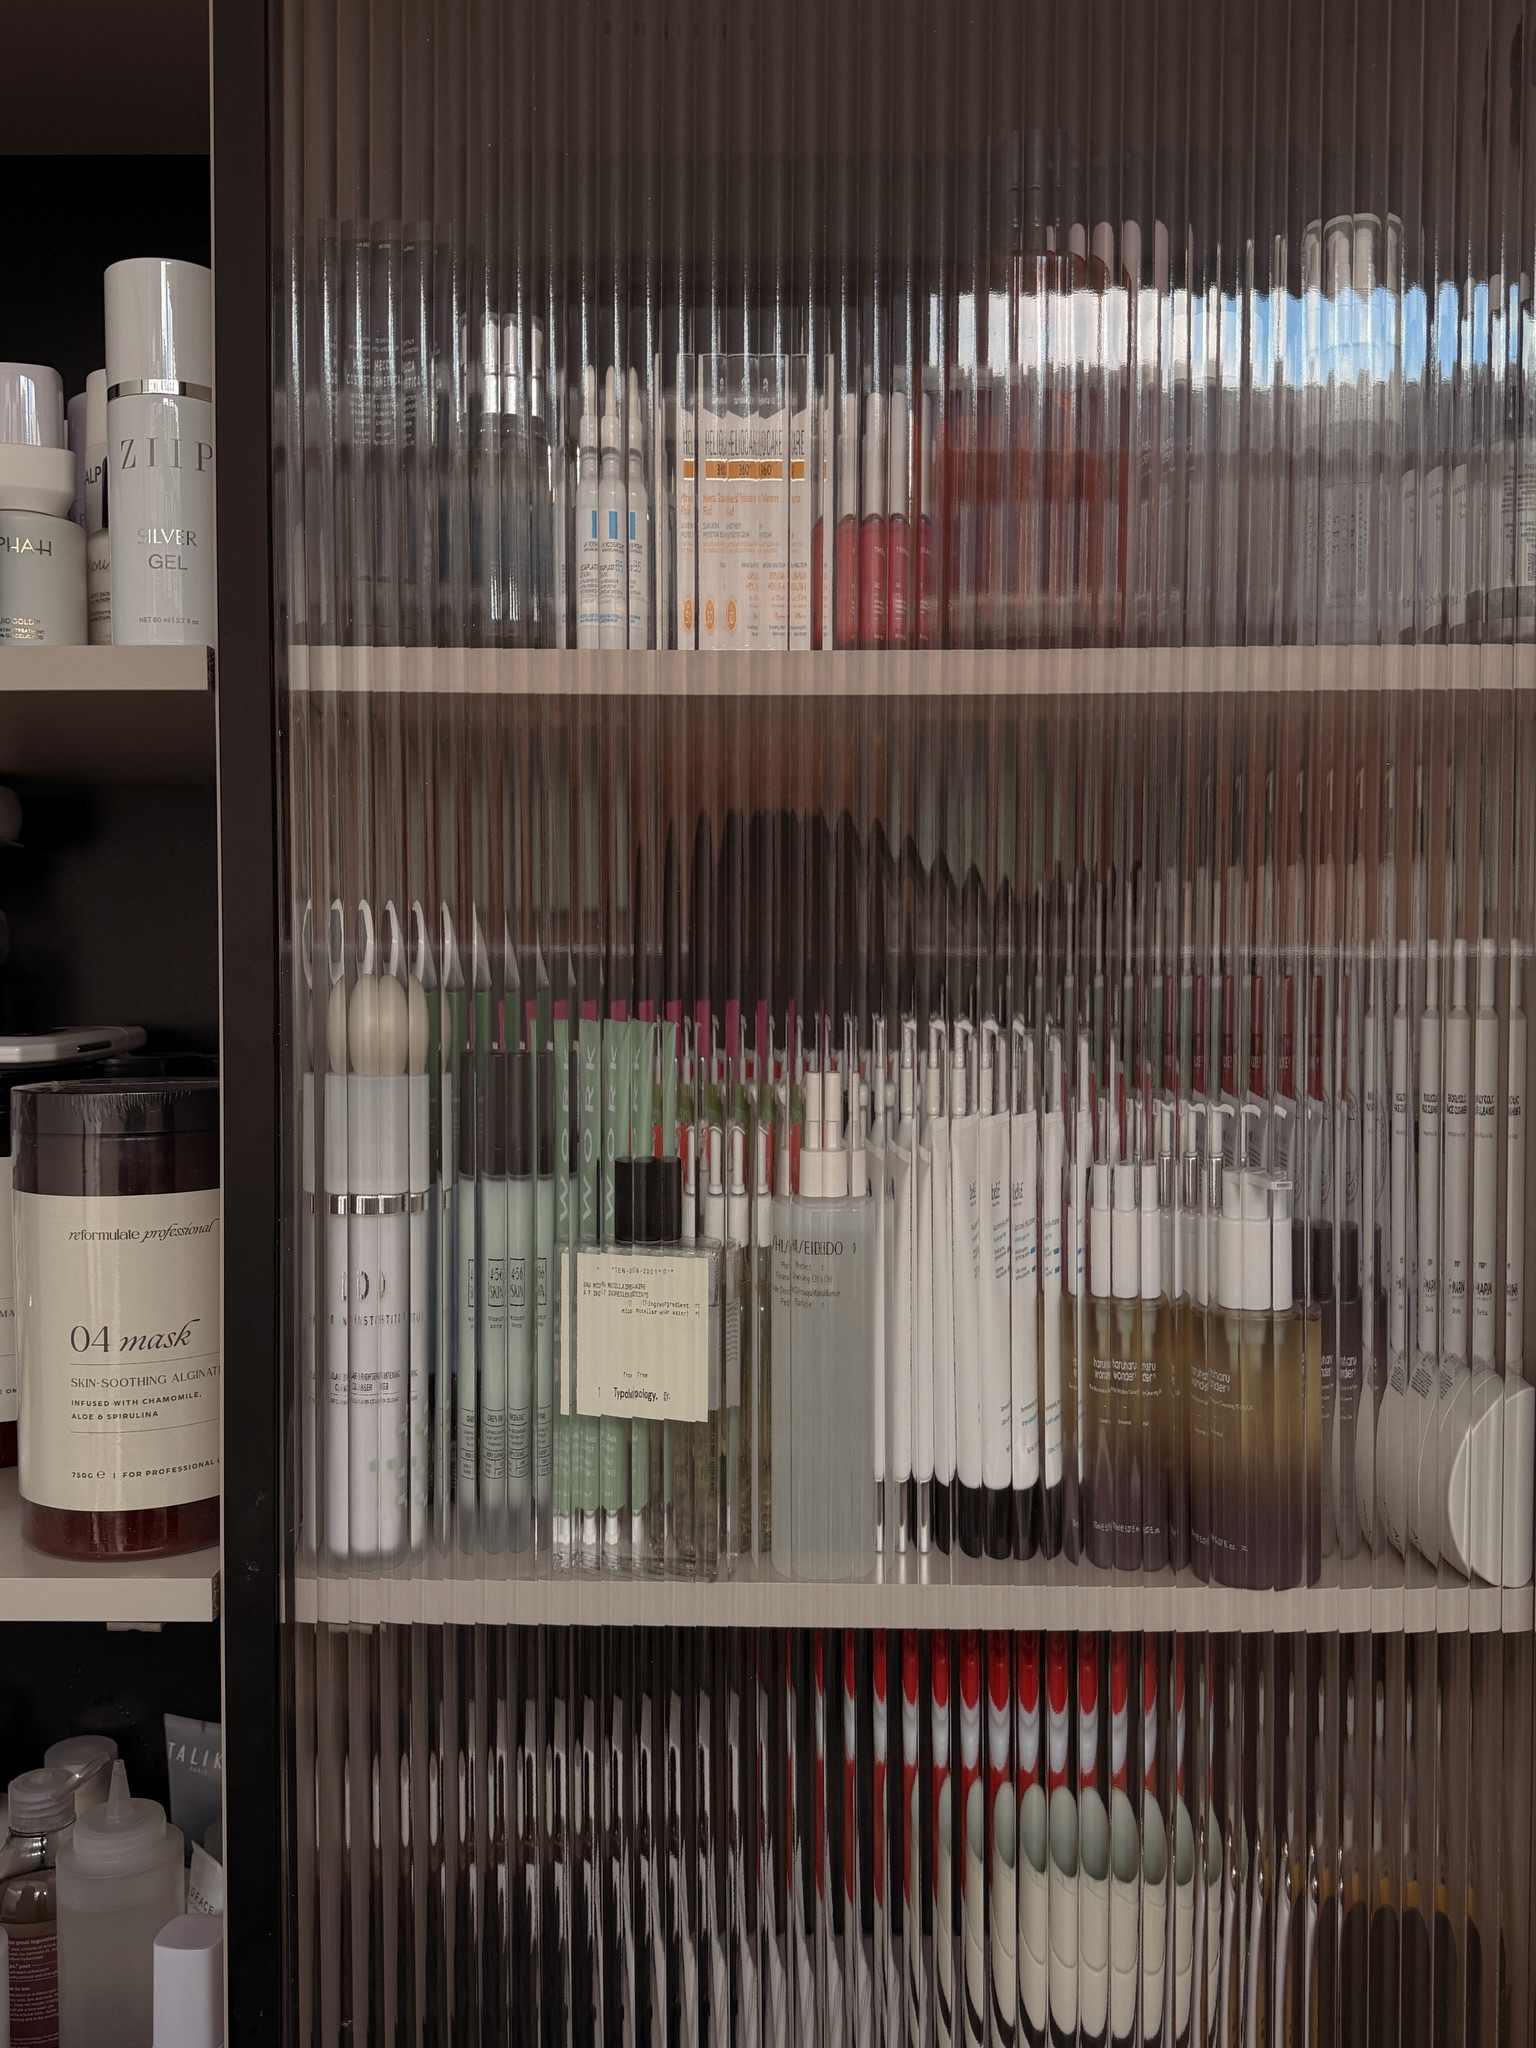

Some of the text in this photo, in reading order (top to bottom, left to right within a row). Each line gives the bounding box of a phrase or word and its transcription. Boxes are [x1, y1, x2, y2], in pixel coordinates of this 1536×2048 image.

[120, 437, 213, 473] ZIIP
[137, 528, 198, 547] SILVER
[148, 553, 189, 571] GEL
[68, 1217, 220, 1243] reformulate professional
[70, 1318, 201, 1353] 04 mask
[70, 1374, 167, 1389] SKIN-SOOTHING
[113, 1399, 139, 1407] WITH
[142, 1391, 202, 1406] CHAMOMILE,
[71, 1413, 94, 1421] ALOE
[106, 1410, 159, 1420] SPIRULINA
[71, 1471, 93, 1479] 750G
[122, 1471, 142, 1479] FOR
[145, 1459, 215, 1477] PROFESSIONAL
